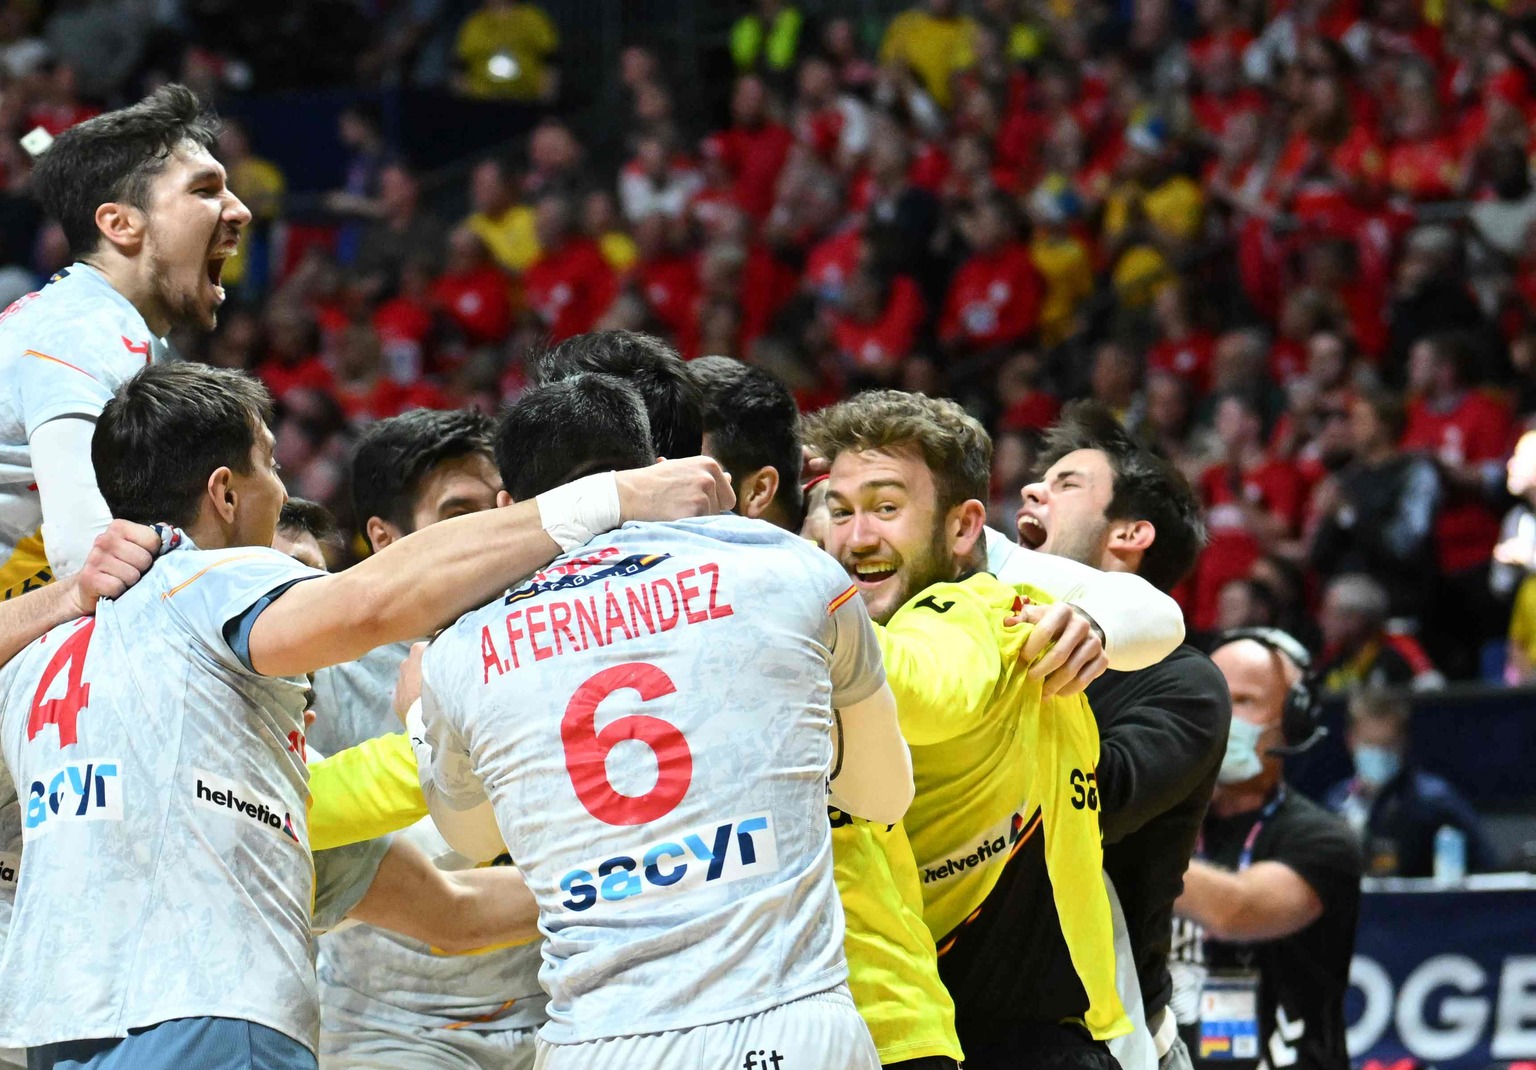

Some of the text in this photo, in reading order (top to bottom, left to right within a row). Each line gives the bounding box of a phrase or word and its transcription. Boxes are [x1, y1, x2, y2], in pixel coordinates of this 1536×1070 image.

[480, 563, 734, 684] A.FERNÁNDEZ
[27, 616, 95, 750] 4
[560, 662, 693, 826] 6
[196, 779, 282, 830] helvetia
[559, 816, 768, 912] sacyr
[923, 835, 1006, 884] helvetia
